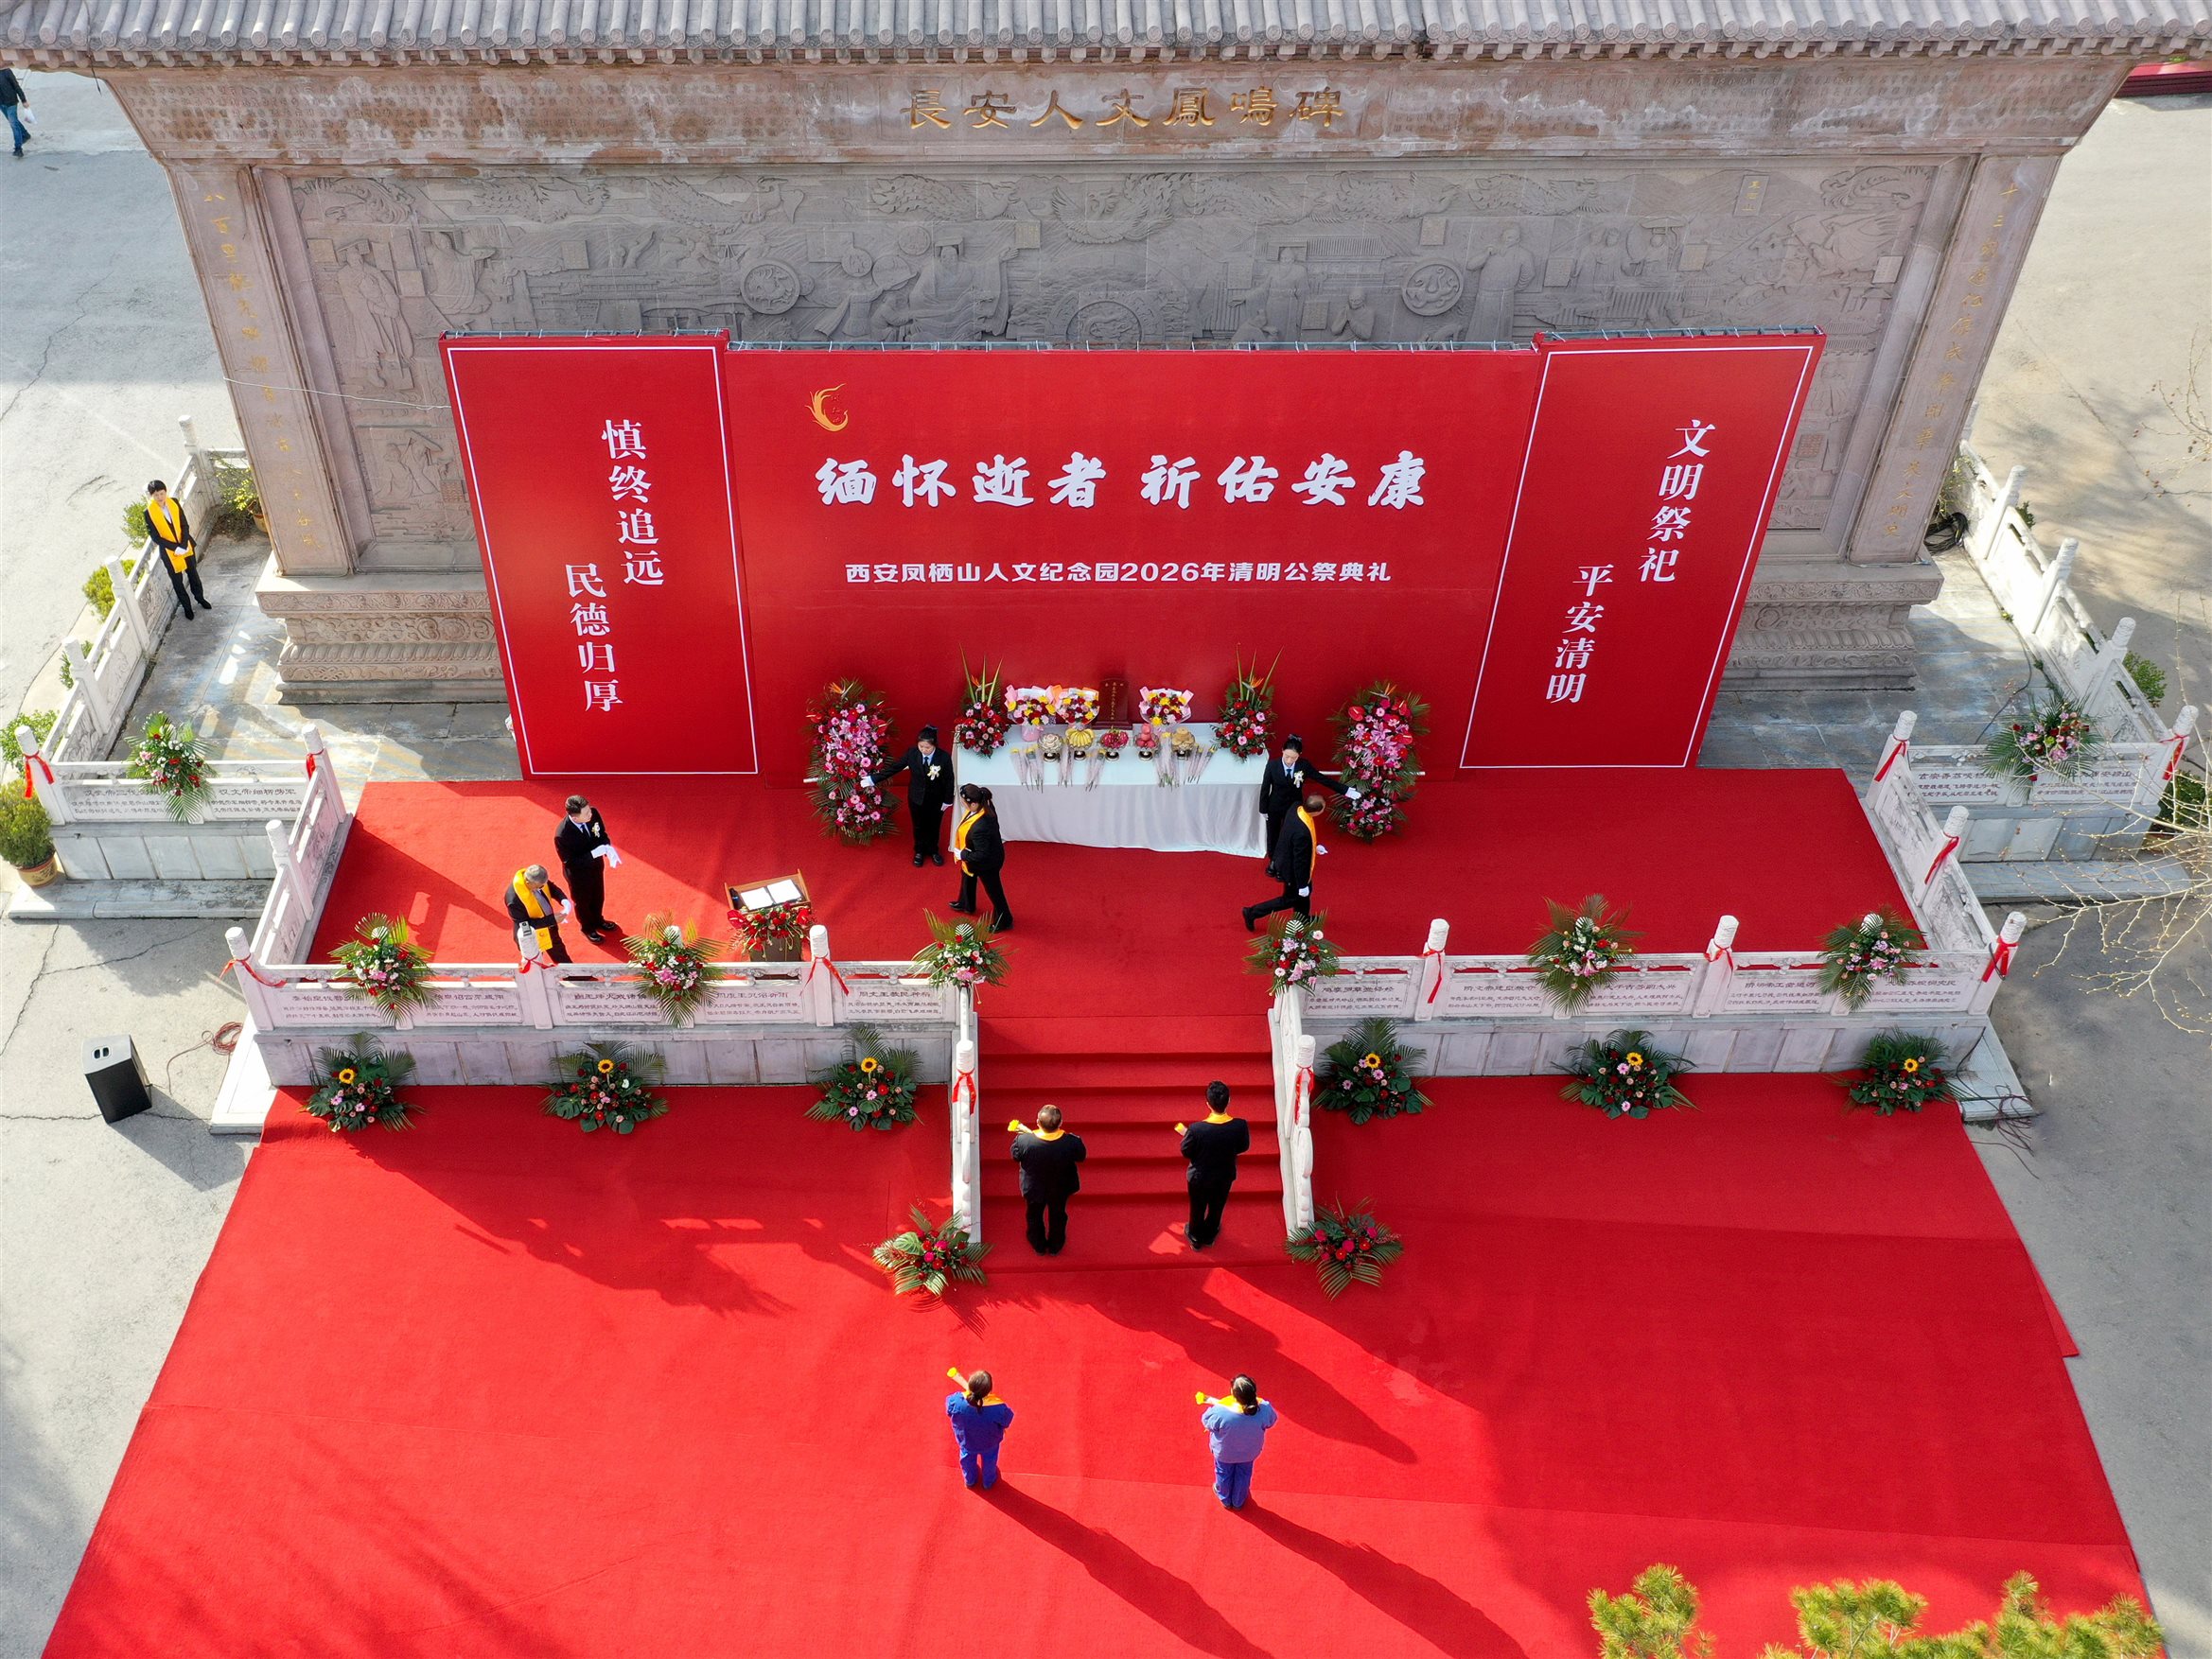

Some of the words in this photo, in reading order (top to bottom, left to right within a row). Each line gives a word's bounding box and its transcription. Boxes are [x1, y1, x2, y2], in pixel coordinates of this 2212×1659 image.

[602, 419, 664, 586] 慎终追远
[815, 452, 1108, 511] 缅怀逝者
[1140, 450, 1427, 511] 祈佑安康
[1638, 419, 1715, 583] 文明祭祀
[565, 564, 623, 712] 民德归厚
[845, 562, 1393, 584] 西安凤栖山人文纪念园2026年清明公祭典礼
[1546, 564, 1614, 704] 平安清明
